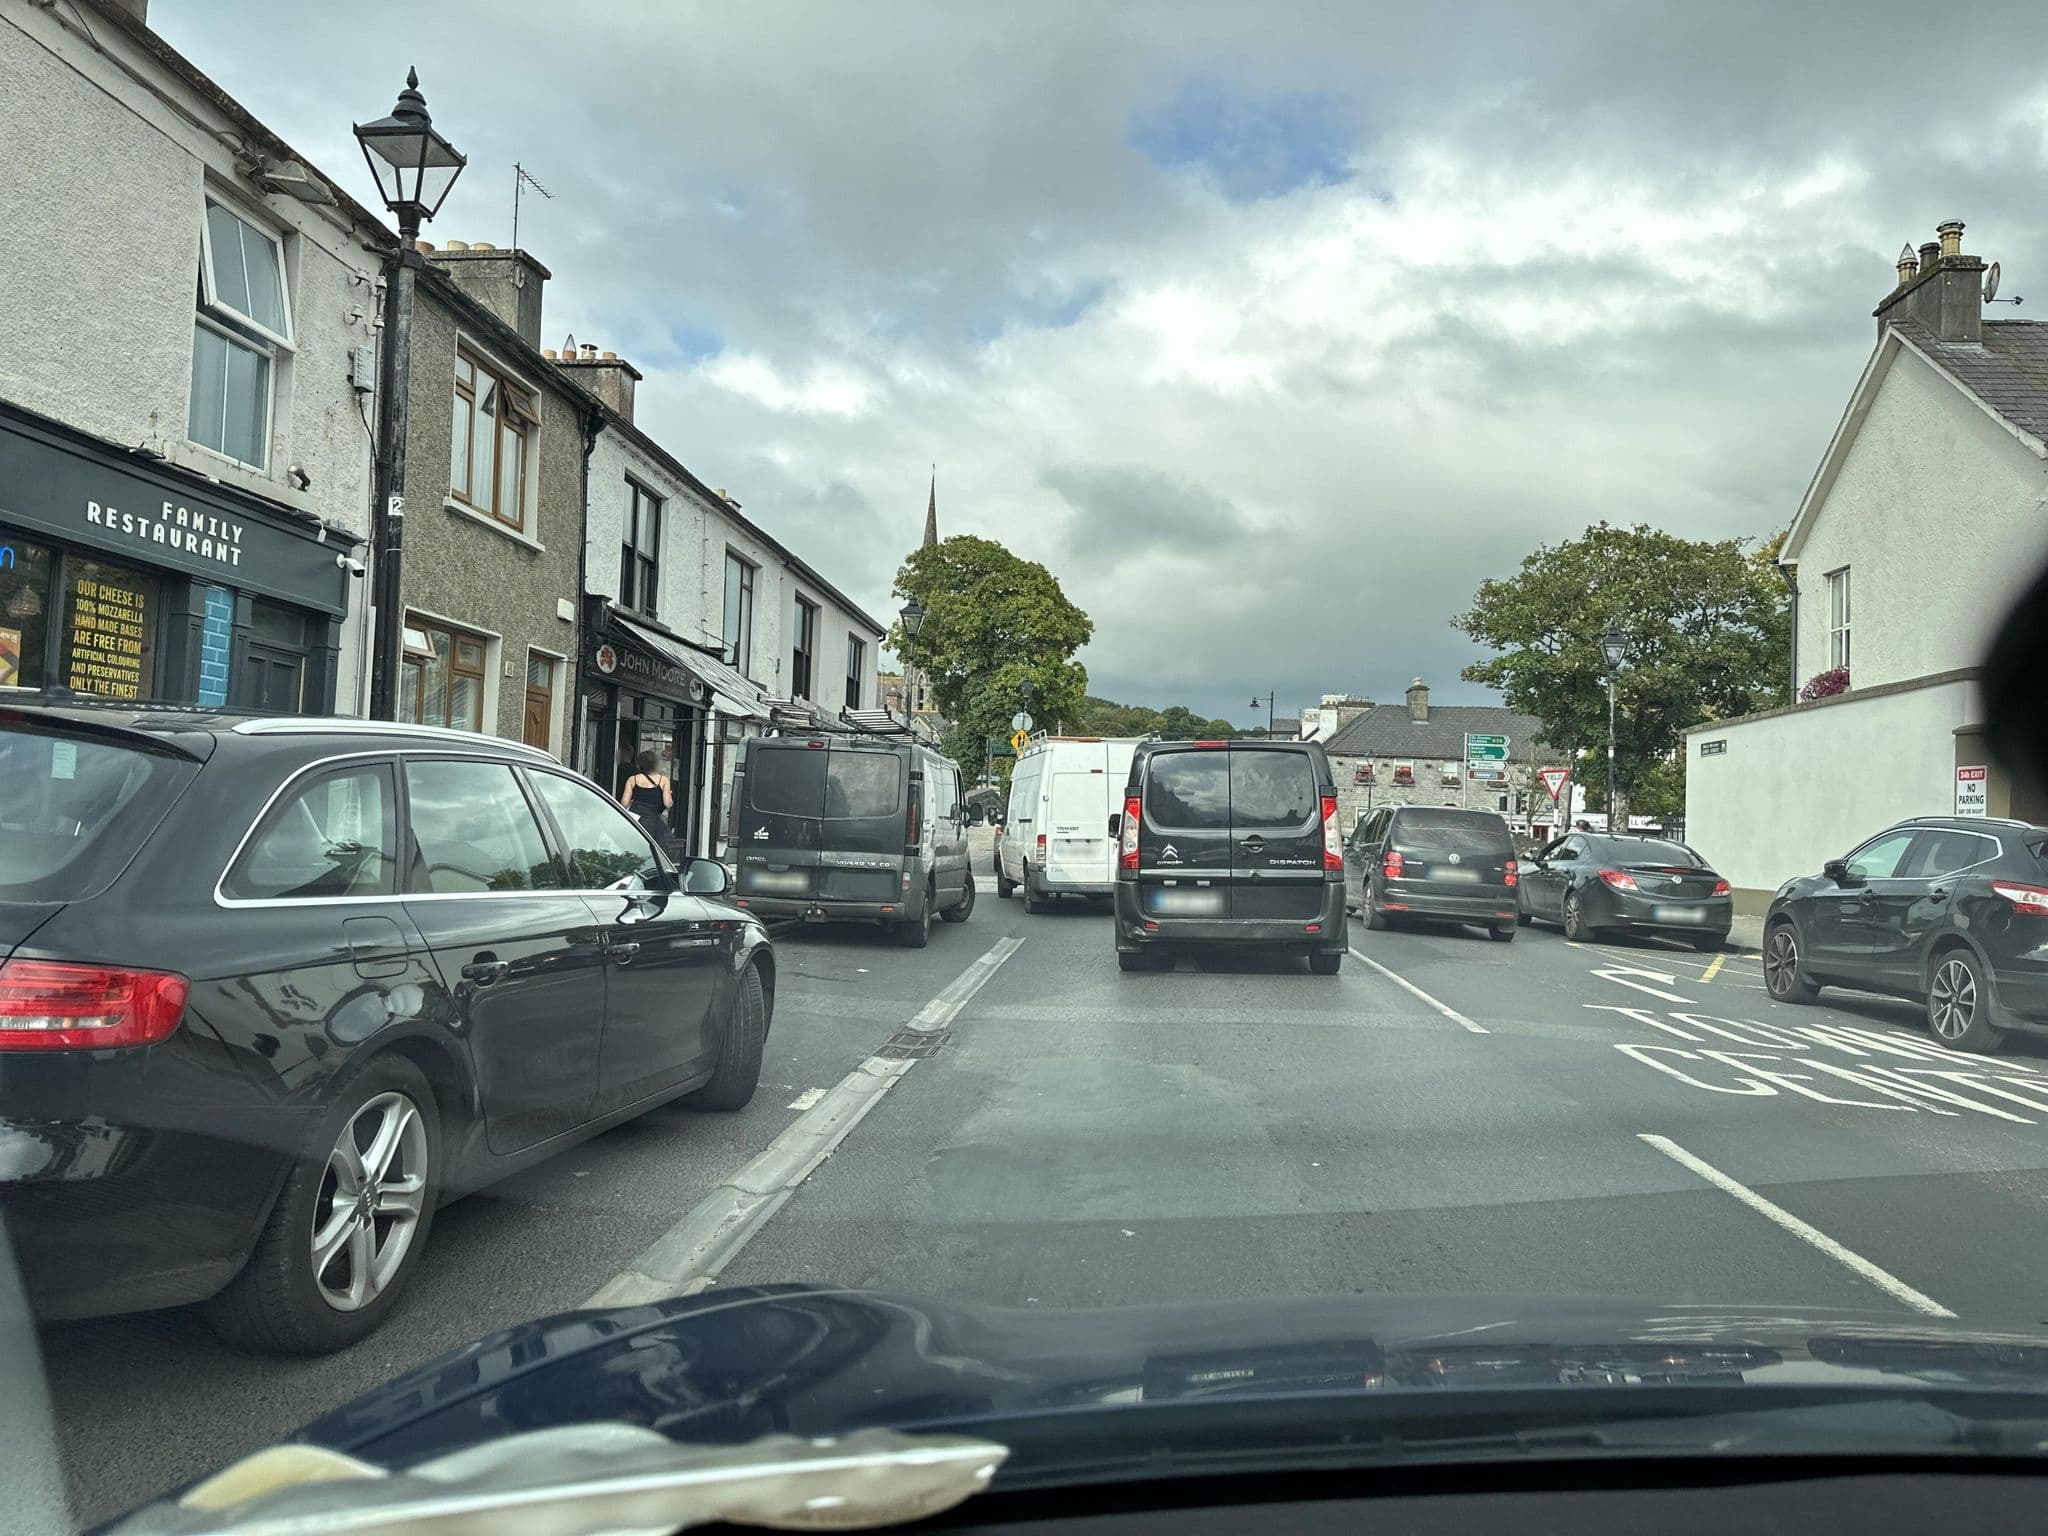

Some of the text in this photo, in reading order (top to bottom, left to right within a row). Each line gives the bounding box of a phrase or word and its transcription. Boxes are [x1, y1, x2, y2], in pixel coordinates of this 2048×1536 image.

[393, 499, 402, 511] 2
[87, 501, 242, 566] RESTAURANT
[161, 501, 243, 544] FAMILY
[77, 579, 144, 609] OUR CHEESE IS
[76, 598, 143, 624] 100% MOZZARELLA
[74, 614, 142, 638] HAND MADE BASES
[73, 630, 141, 655] ARE FREE FROM
[71, 648, 140, 669] ARTIFICIAL COLOURING
[620, 649, 649, 675] JOHN
[651, 658, 686, 687] MOORE
[71, 662, 140, 683] AND PRESERVATIVES
[70, 676, 138, 699] ONLY THE FINEST
[1959, 794, 1984, 804] PARKING
[1967, 783, 1976, 793] NO
[1583, 1004, 2039, 1073] TOWN
